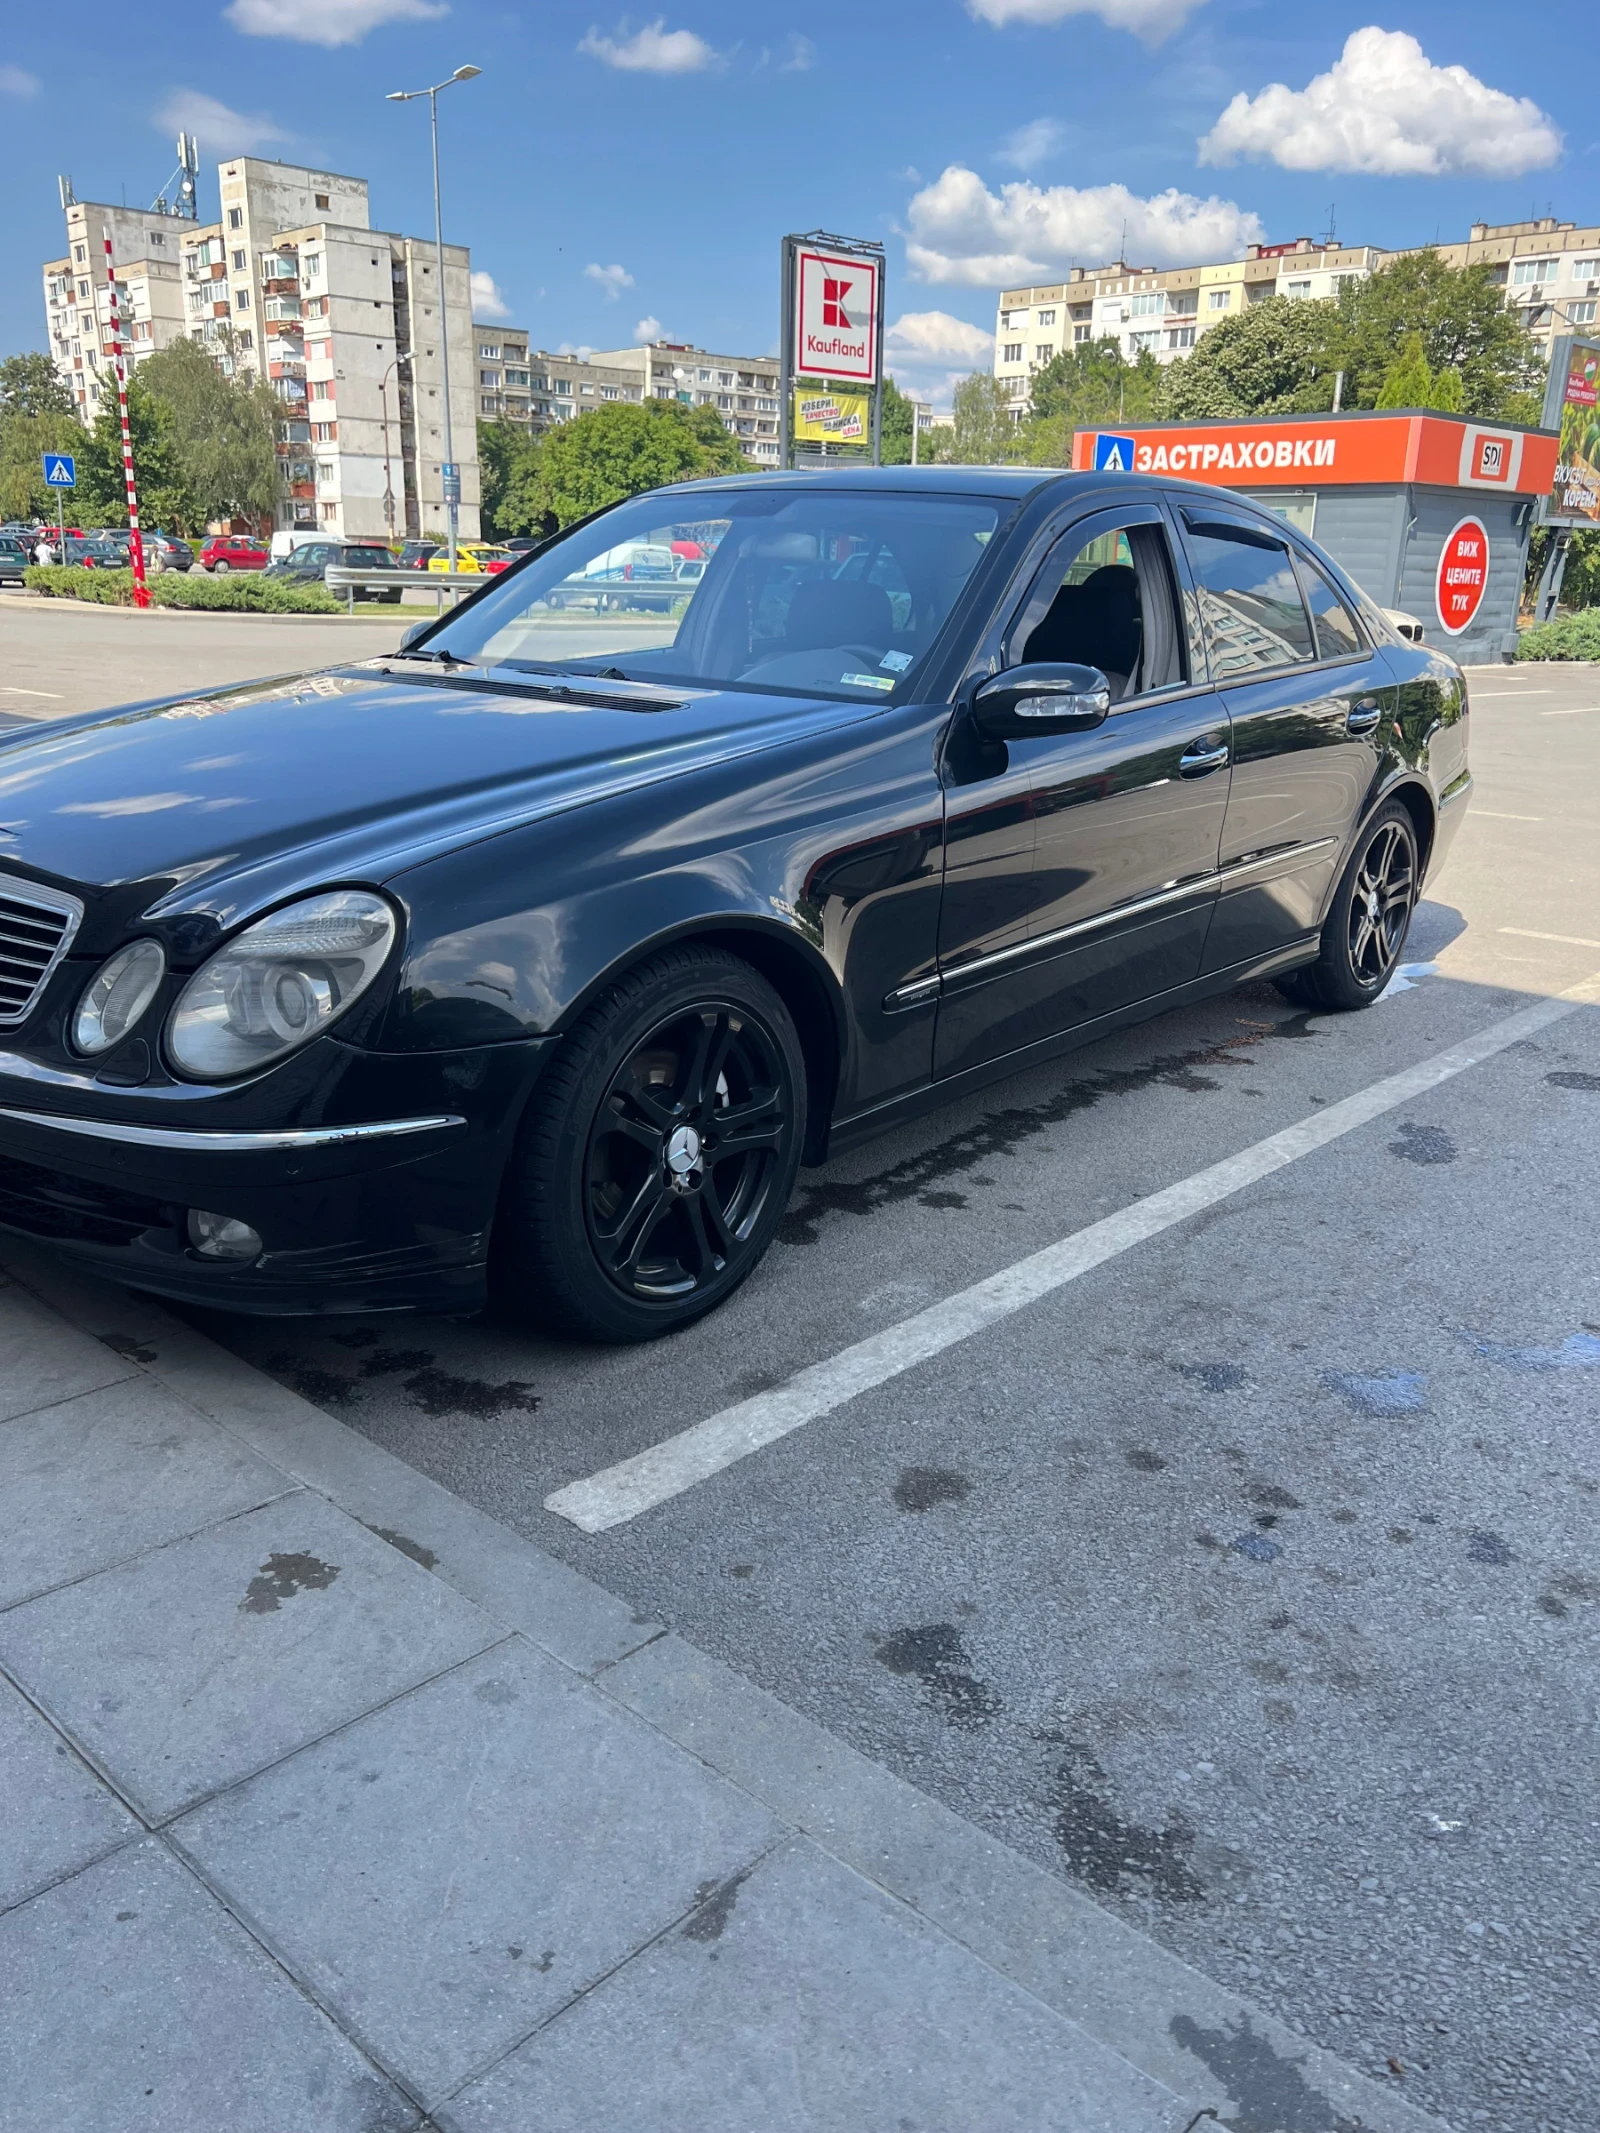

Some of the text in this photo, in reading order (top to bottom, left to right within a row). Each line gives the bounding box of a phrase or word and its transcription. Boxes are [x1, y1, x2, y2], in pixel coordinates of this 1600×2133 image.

[807, 334, 865, 358] Kaufland
[801, 399, 831, 412] ИЗБЕРИ
[805, 408, 839, 420] КАЧЕСТВО
[832, 415, 858, 429] НИСКА
[842, 426, 860, 436] ЦЕНА
[1136, 438, 1336, 472] ЗАСТРАХОВКИ
[1483, 445, 1502, 467] SDI
[1554, 465, 1586, 484] ВКУСЪТ
[1563, 489, 1596, 507] КОРЕНА
[1457, 540, 1478, 557] ВИЖ
[1446, 567, 1481, 586] ЦЕНИТЕ
[1452, 593, 1469, 612] ТУК
